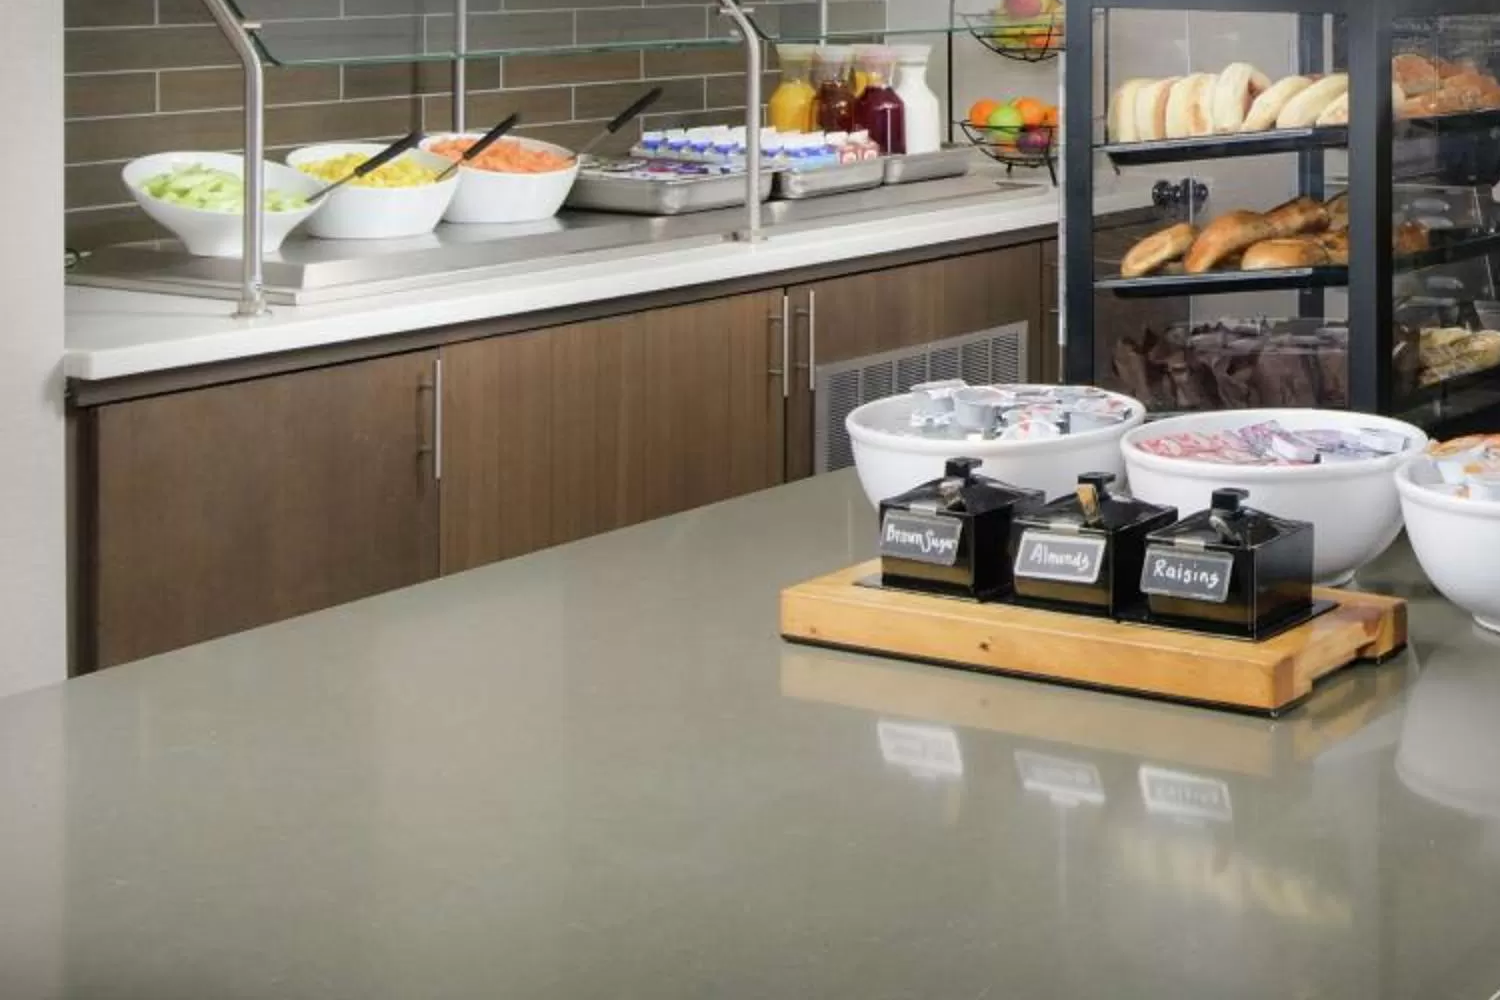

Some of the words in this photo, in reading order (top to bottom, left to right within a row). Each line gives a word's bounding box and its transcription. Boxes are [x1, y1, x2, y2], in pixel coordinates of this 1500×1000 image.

[886, 523, 922, 545] Brown
[1029, 542, 1090, 573] Almonds
[1153, 558, 1220, 589] Raisins
